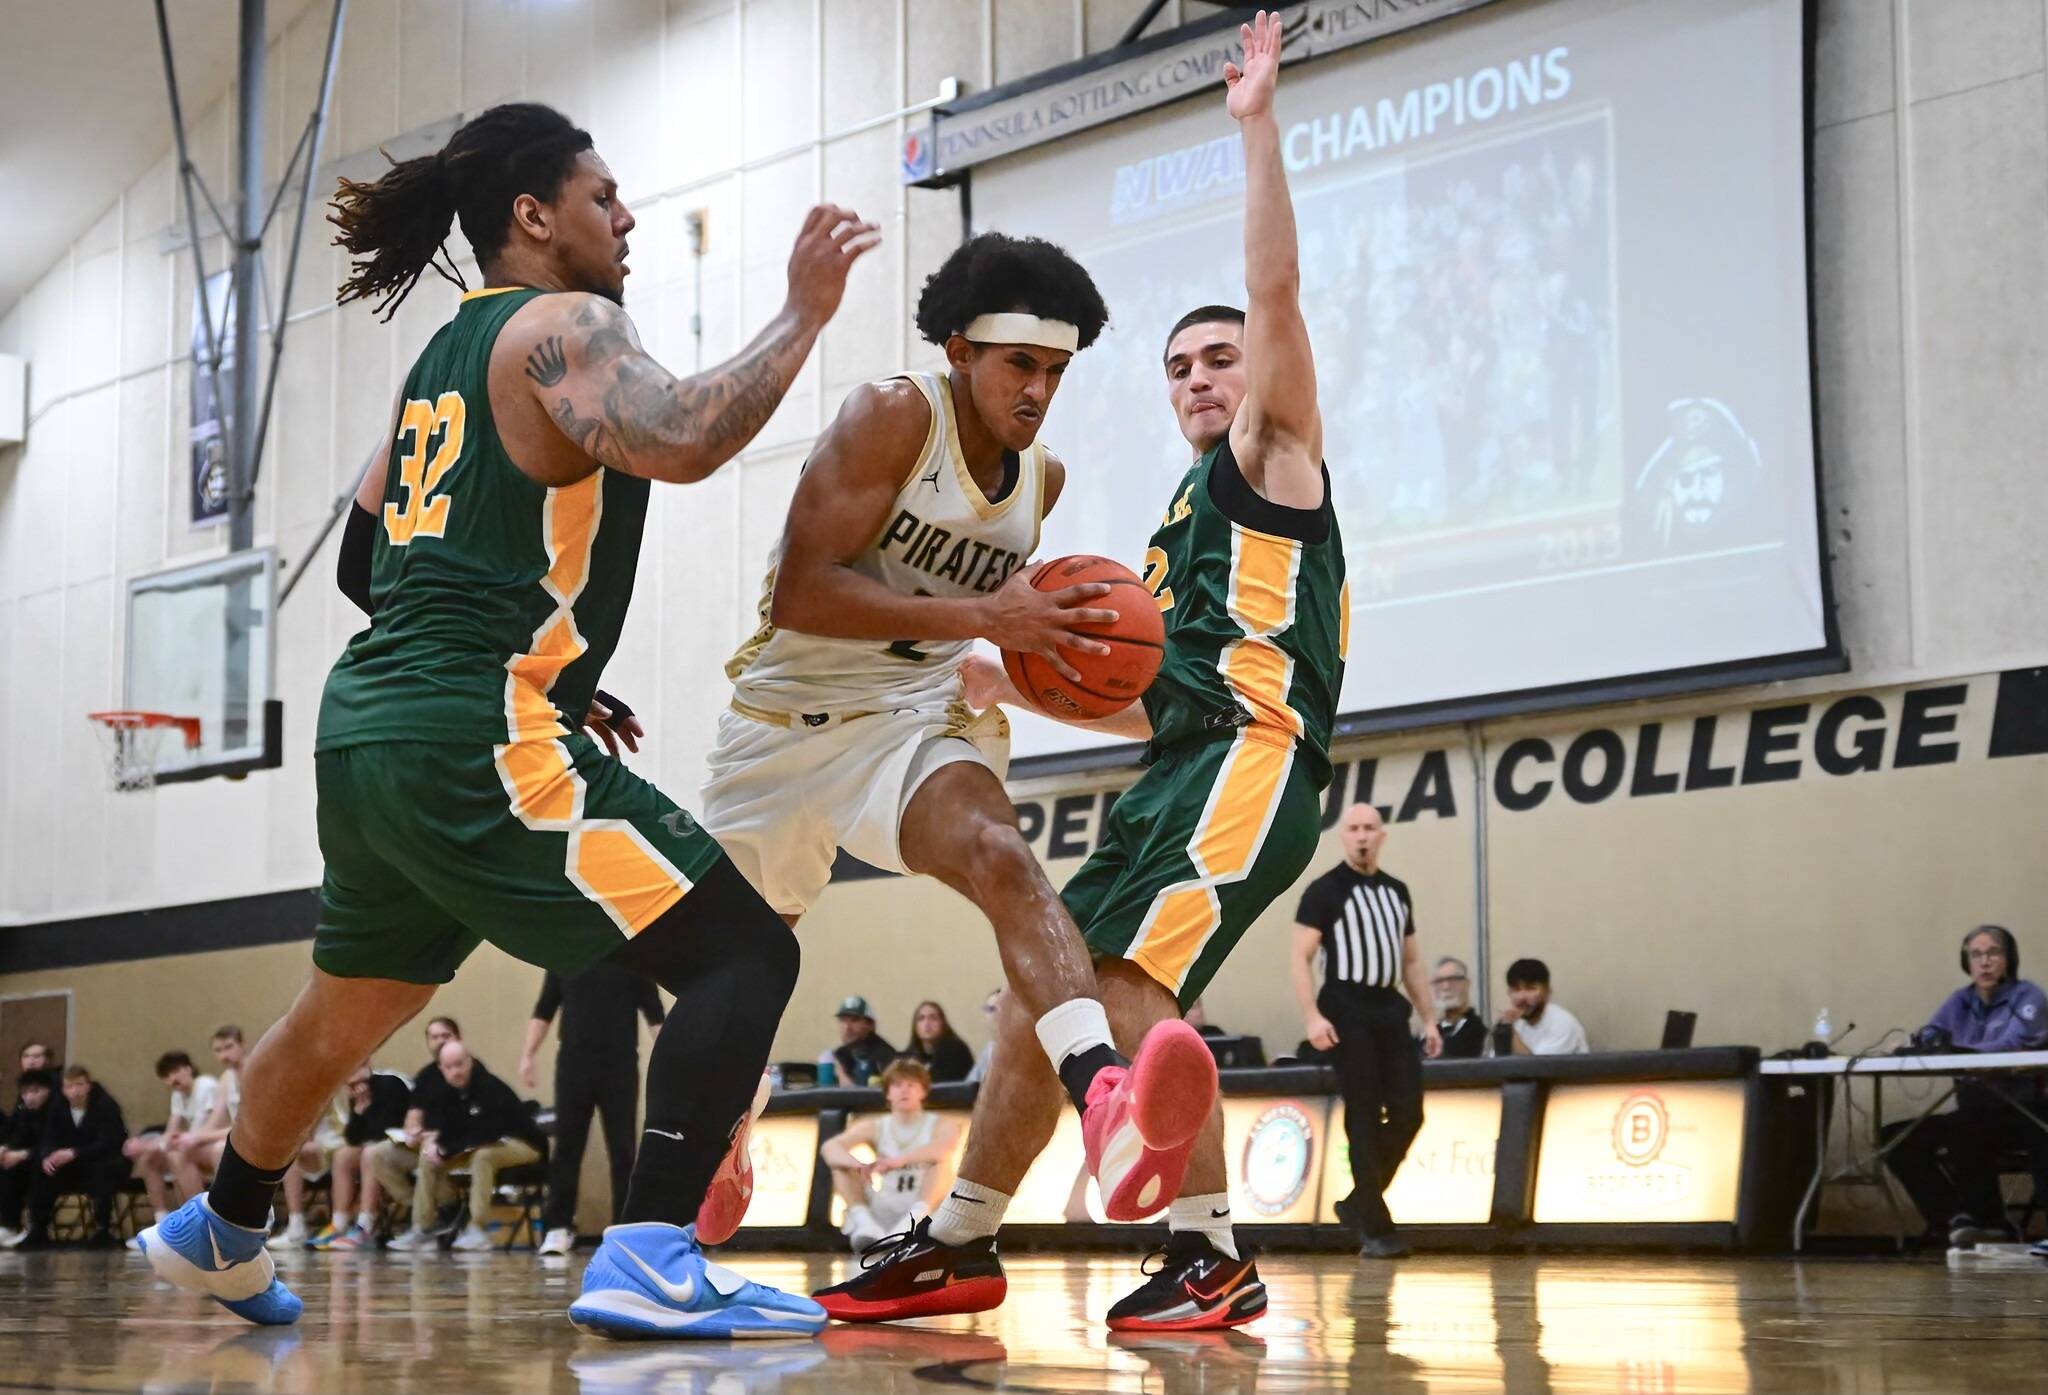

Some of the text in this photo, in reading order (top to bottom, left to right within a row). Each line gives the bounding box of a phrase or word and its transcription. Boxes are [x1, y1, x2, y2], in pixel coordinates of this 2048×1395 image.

[1048, 72, 1152, 126] BOTTLING
[1156, 40, 1246, 89] COMPAN
[1111, 47, 1572, 215] NWA CHAMPIONS
[384, 390, 465, 545] 32
[880, 509, 1019, 592] PIRATES
[1494, 684, 1968, 811] COLLEGE
[1631, 1115, 1651, 1144] B
